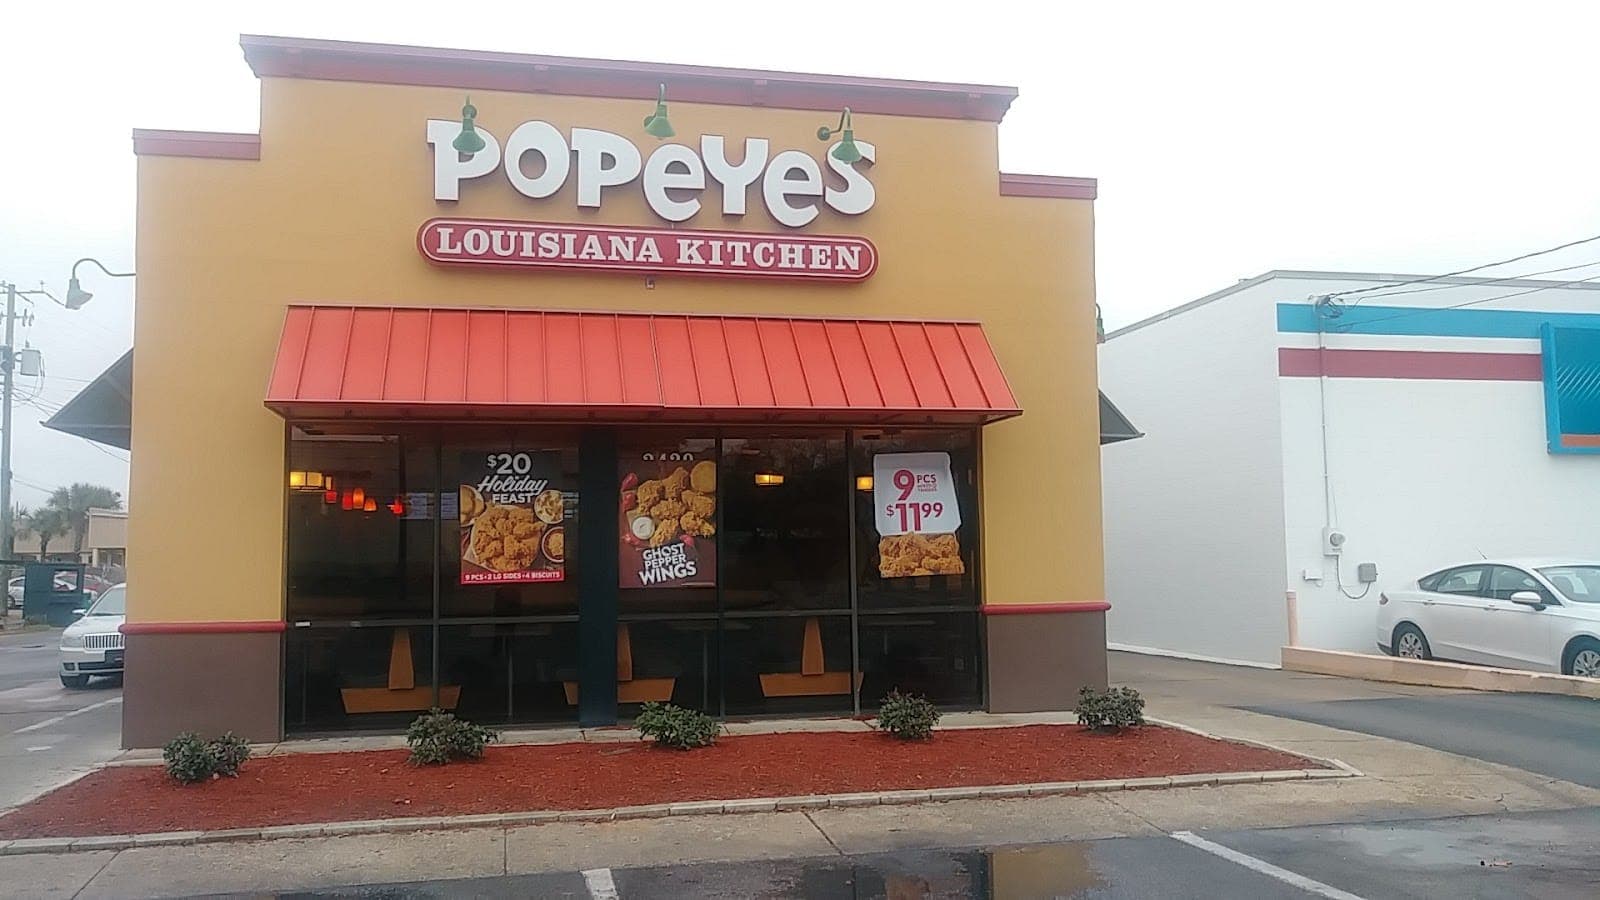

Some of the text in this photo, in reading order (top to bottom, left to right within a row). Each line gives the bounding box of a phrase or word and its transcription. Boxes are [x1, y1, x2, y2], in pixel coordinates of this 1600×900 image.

[436, 227, 862, 271] LOUISIANA KITCHEN
[487, 453, 531, 475] $20
[476, 475, 548, 495] Holiday
[893, 469, 937, 501] 9 PCS
[492, 493, 532, 503] FEAST
[643, 543, 685, 560] GHOST
[644, 554, 687, 569] PEPPER
[471, 573, 484, 581] PCS
[503, 572, 521, 580] SIDES
[531, 571, 560, 579] BISCUITS
[639, 562, 696, 585] WINGS
